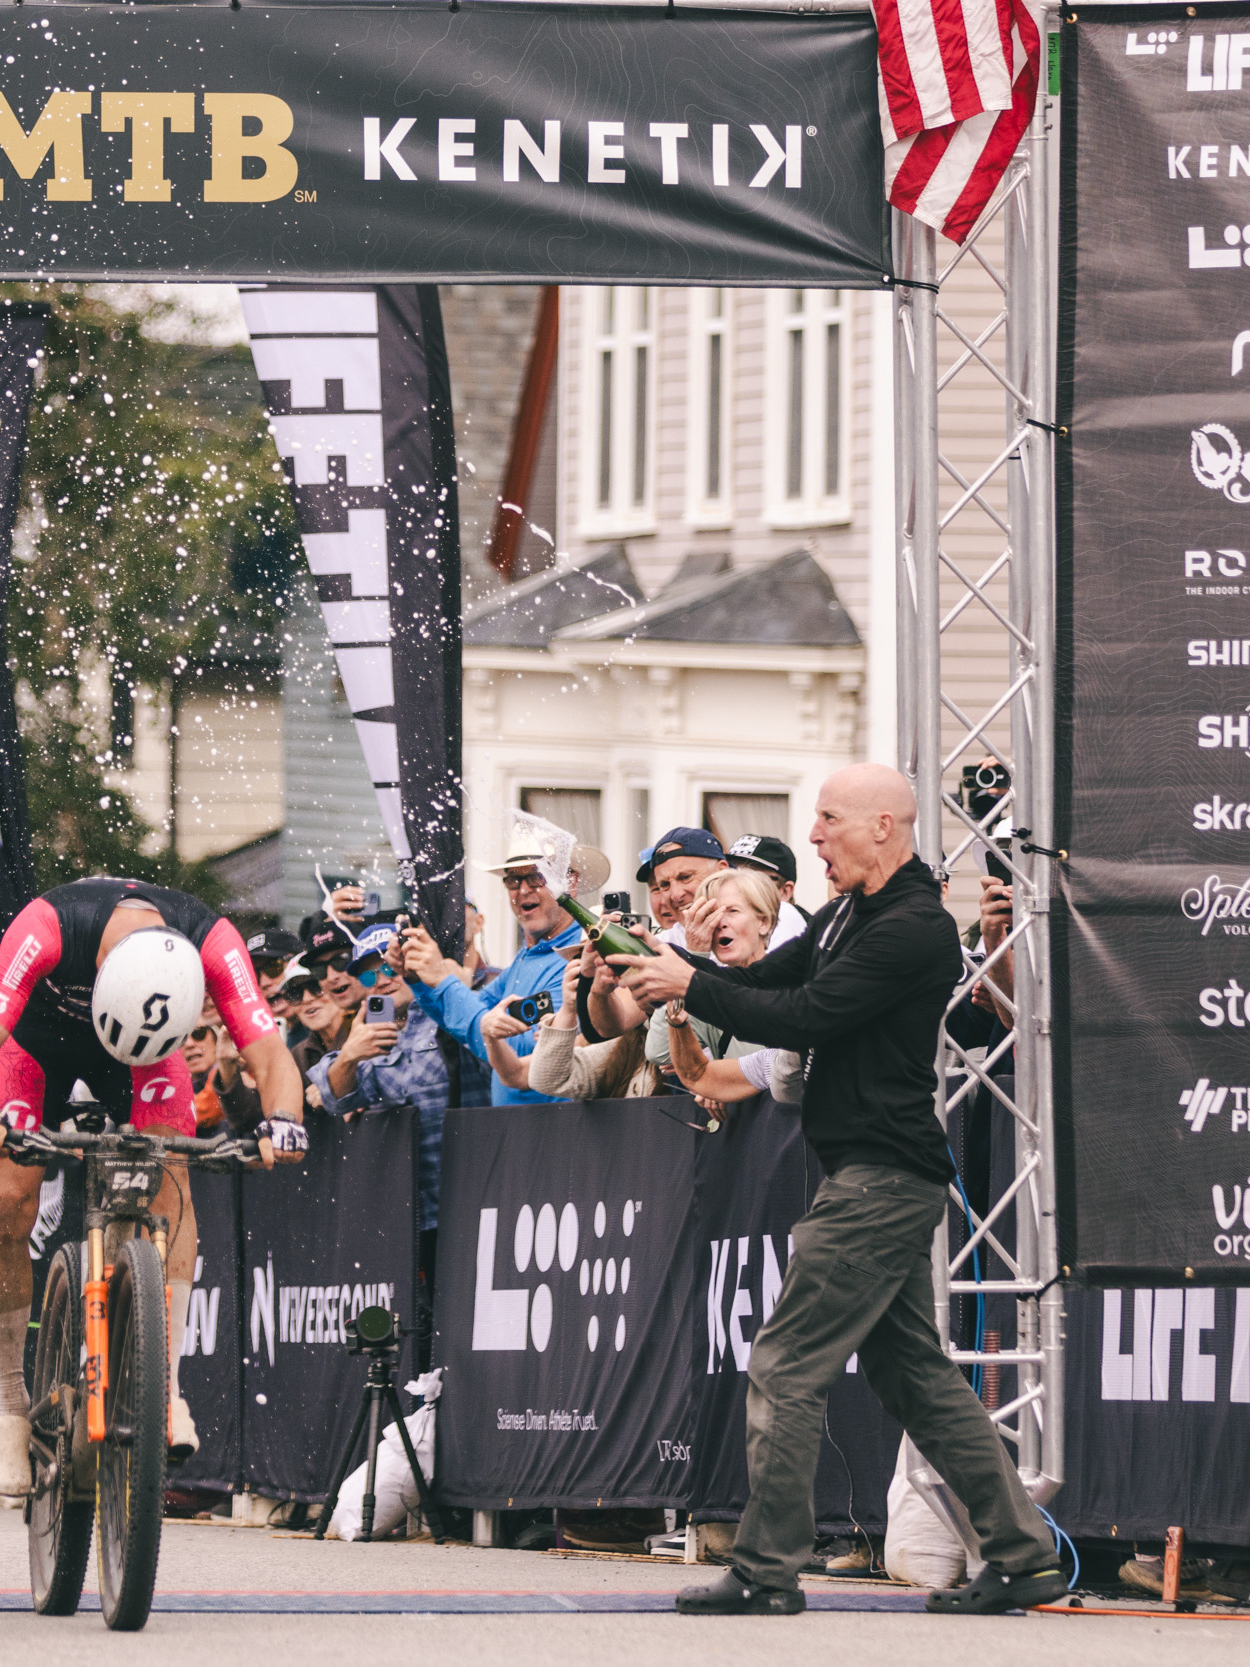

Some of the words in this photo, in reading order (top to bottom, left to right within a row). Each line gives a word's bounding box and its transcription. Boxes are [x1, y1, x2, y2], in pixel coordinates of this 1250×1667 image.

[1185, 587, 1203, 595] THE
[1205, 586, 1240, 595] INDOOR
[2, 934, 42, 991] PIRELLI
[223, 948, 258, 1004] PIRELLI
[112, 1171, 149, 1190] 54
[1101, 1288, 1216, 1402] LIFE
